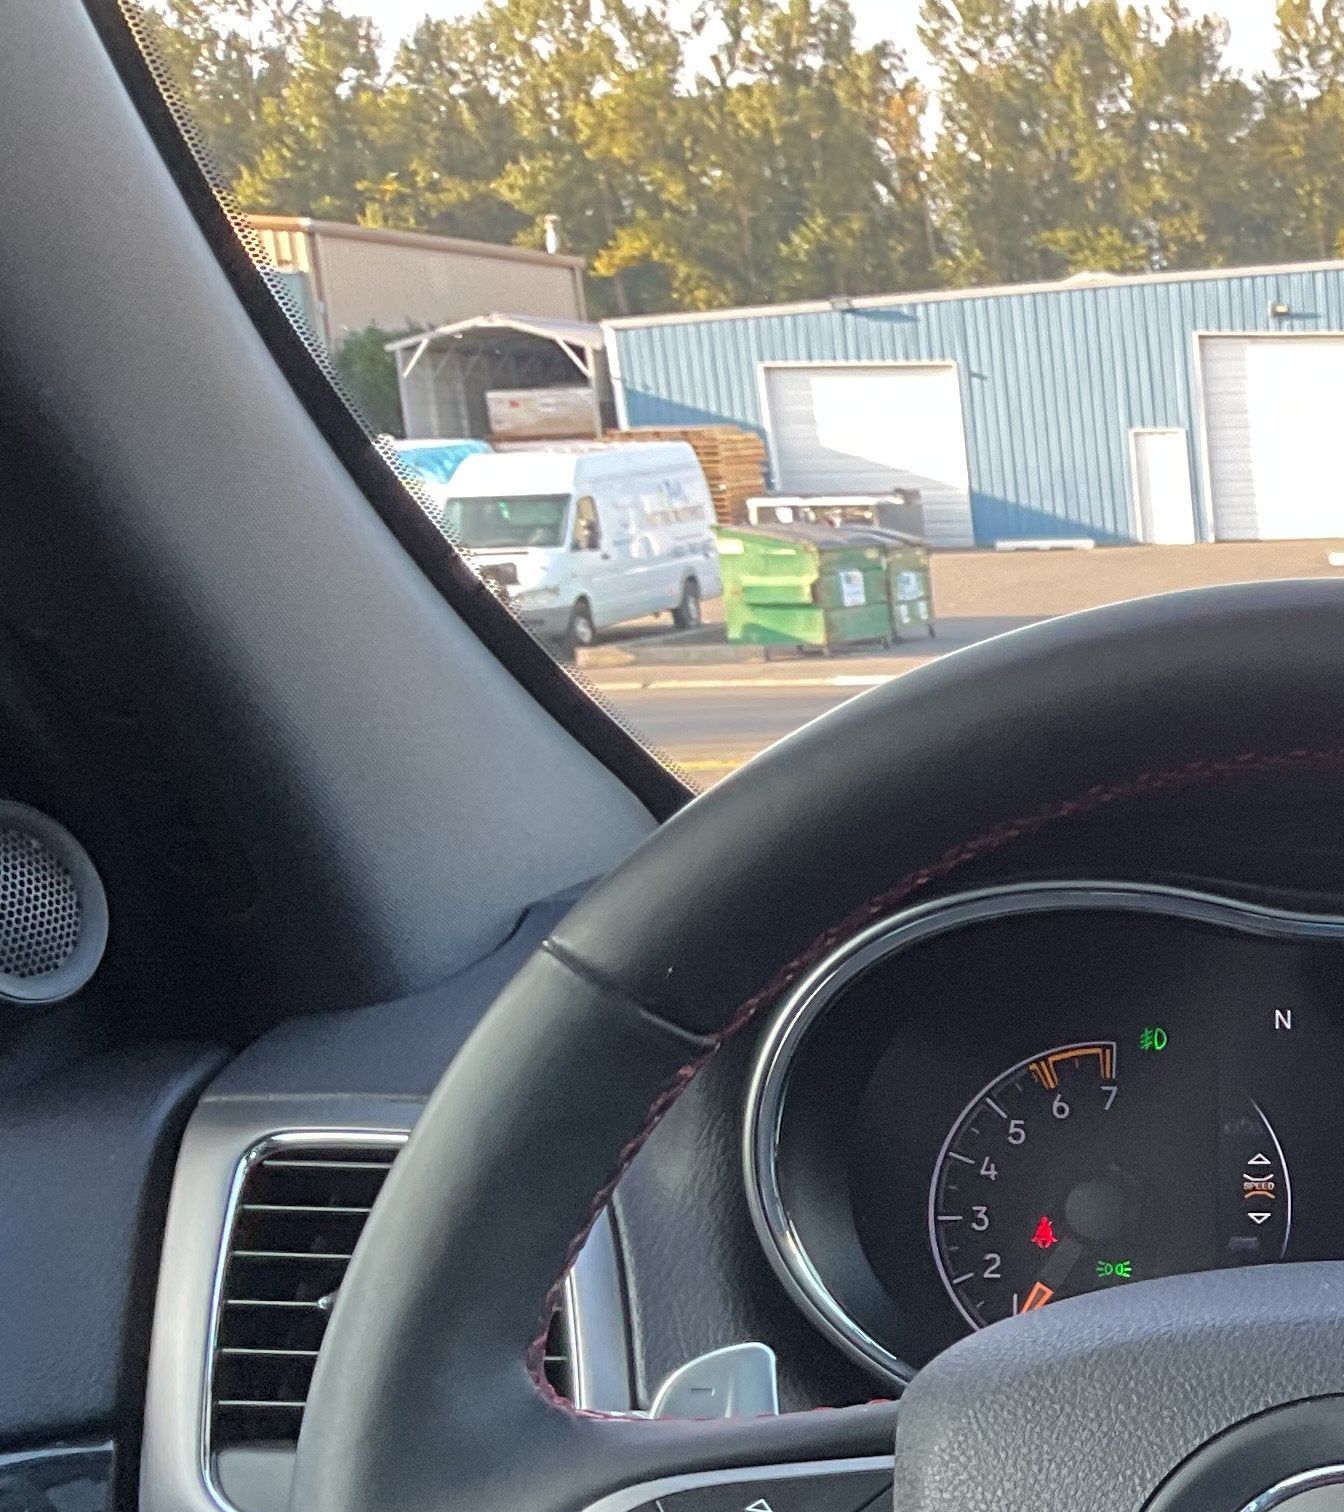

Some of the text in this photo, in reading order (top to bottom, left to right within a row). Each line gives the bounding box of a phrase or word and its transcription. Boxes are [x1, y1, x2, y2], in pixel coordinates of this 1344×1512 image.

[1274, 1009, 1292, 1029] N
[1052, 1093, 1070, 1119] 6
[1101, 1085, 1118, 1111] 7
[1007, 1119, 1026, 1145] 5
[980, 1156, 998, 1181] 4
[970, 1206, 990, 1231] 3
[983, 1253, 1001, 1279] 2
